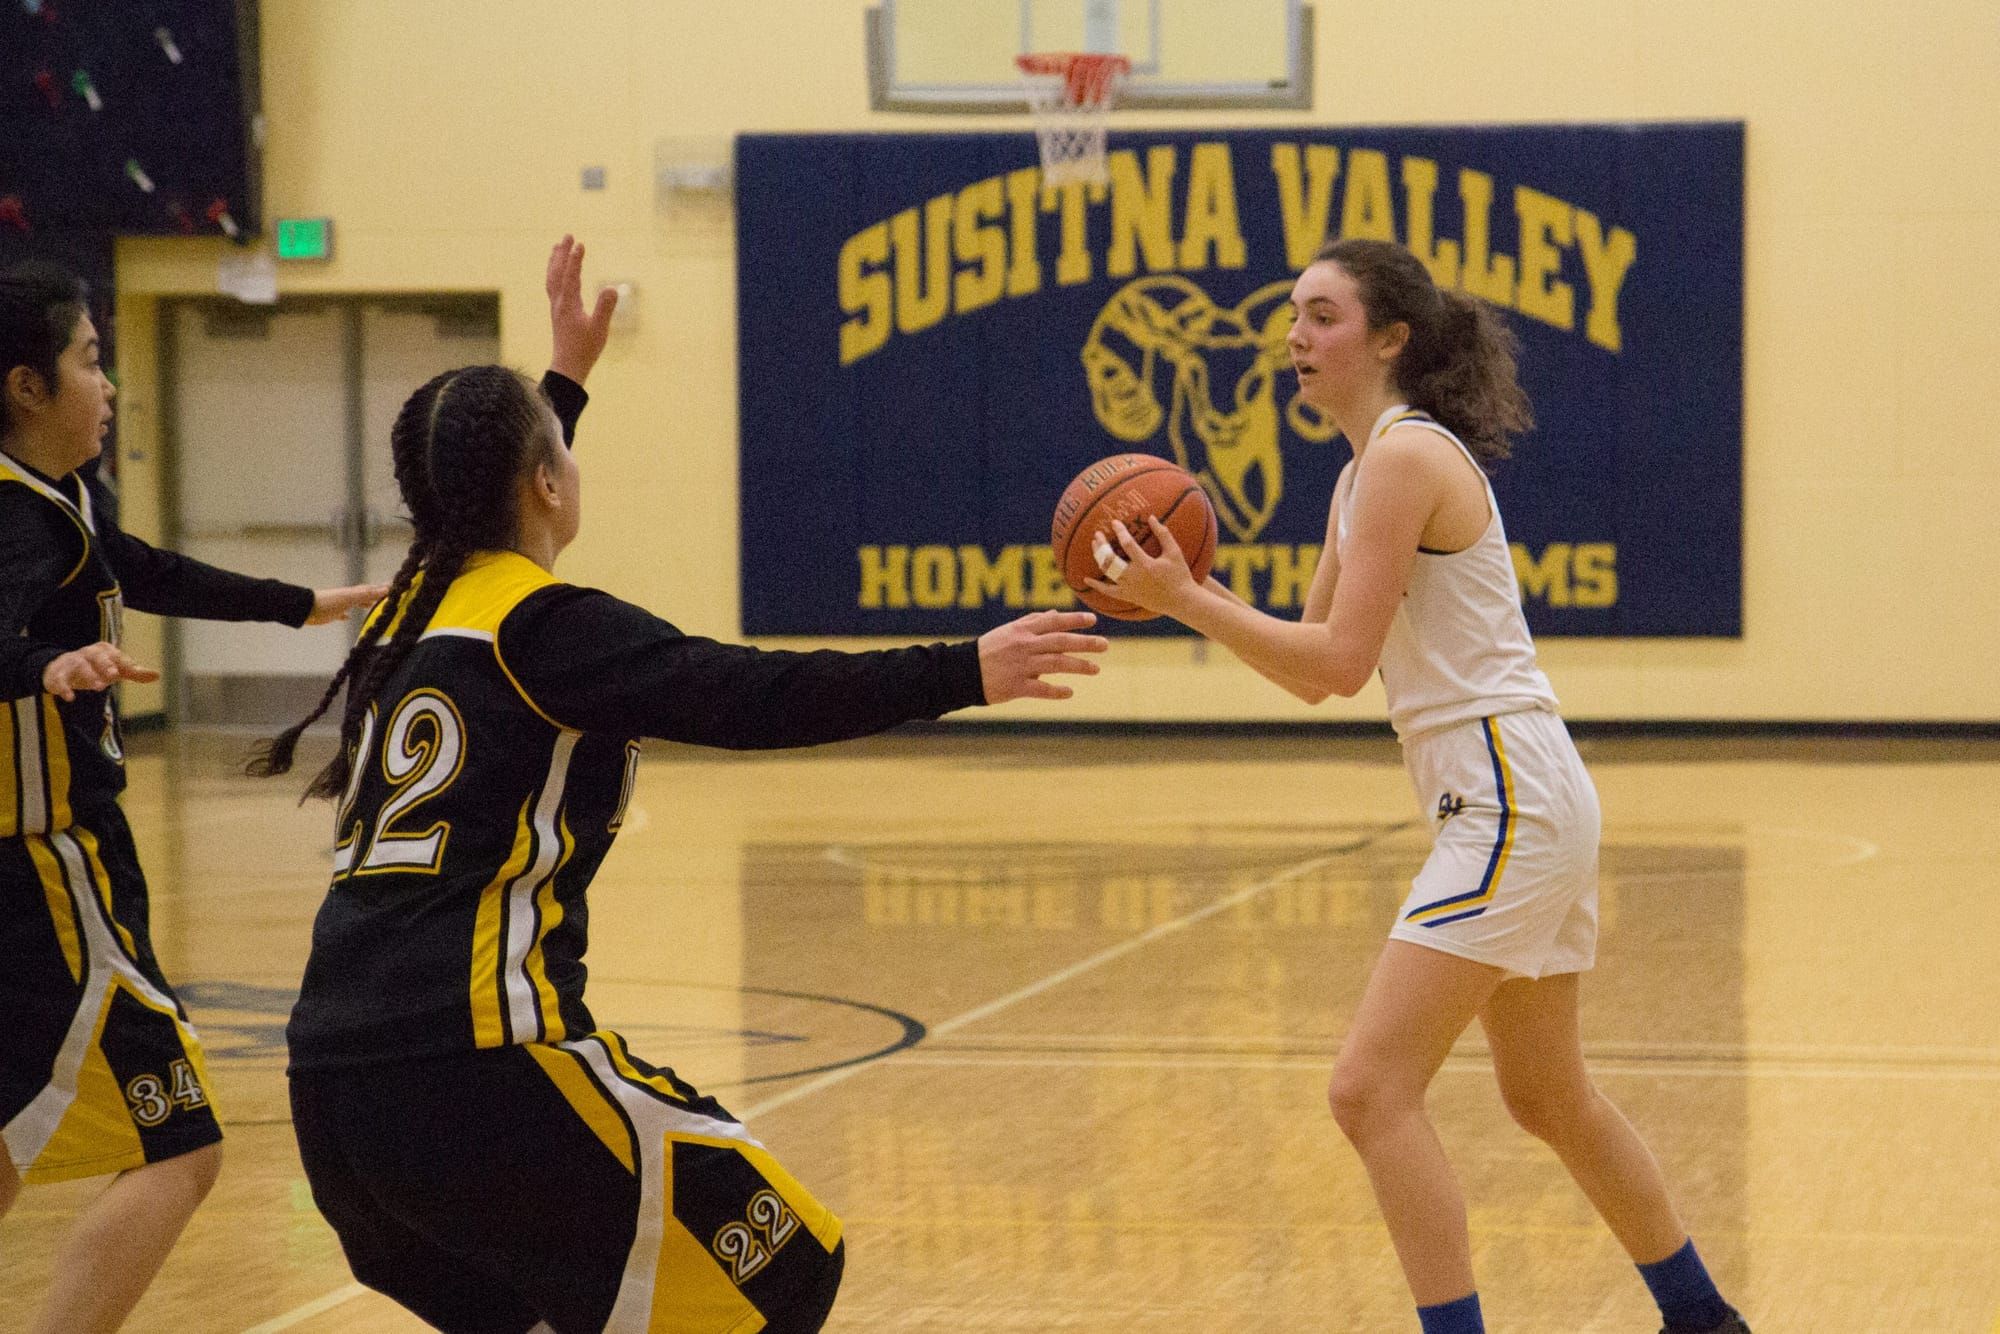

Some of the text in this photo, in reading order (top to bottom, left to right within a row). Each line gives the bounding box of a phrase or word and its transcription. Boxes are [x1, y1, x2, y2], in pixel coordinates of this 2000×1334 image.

[838, 143, 1637, 366] SUSITNA VALLEY
[858, 542, 1618, 608] HOME TH MS
[127, 1058, 209, 1127] 34
[712, 1189, 801, 1285] 22
